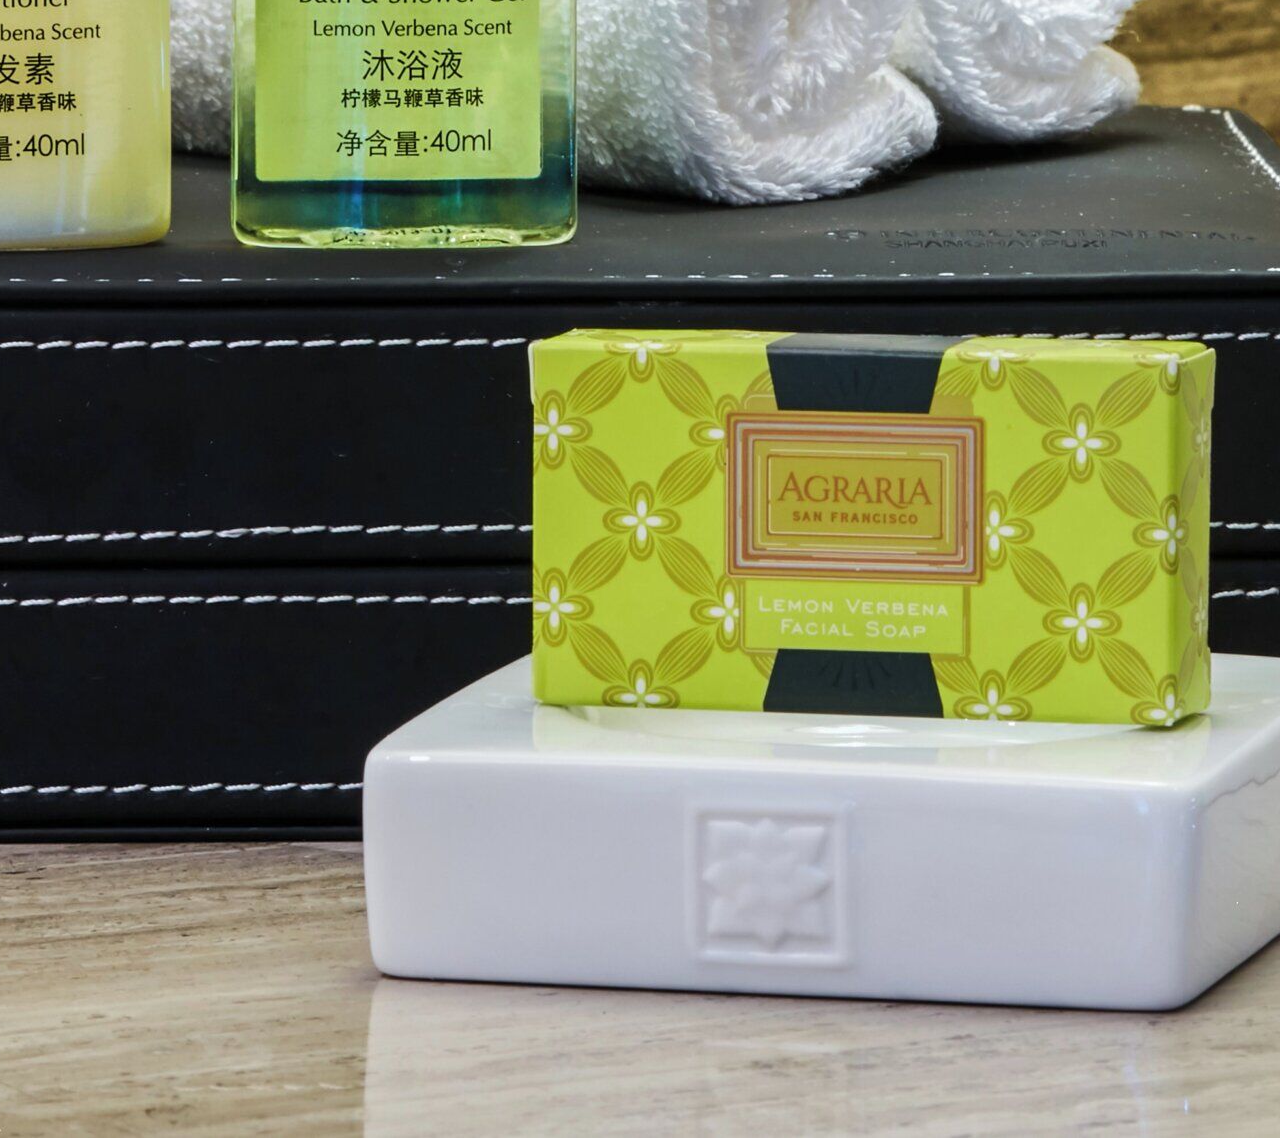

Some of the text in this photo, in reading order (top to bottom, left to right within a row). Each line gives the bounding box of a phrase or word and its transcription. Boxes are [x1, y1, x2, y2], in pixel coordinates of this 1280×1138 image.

[52, 23, 100, 40] Scent
[314, 19, 512, 36] Lemon Verbena Scent
[363, 48, 463, 81] 沐浴液
[341, 86, 483, 108] 柠檬马鞭草香味
[336, 128, 491, 157] 净含量:40ml
[778, 471, 932, 510] AGRARIA
[792, 511, 918, 525] SAN FRANCISCO
[758, 596, 948, 617] LEMON VERBENA
[780, 619, 926, 638] FACIAL SOAP
